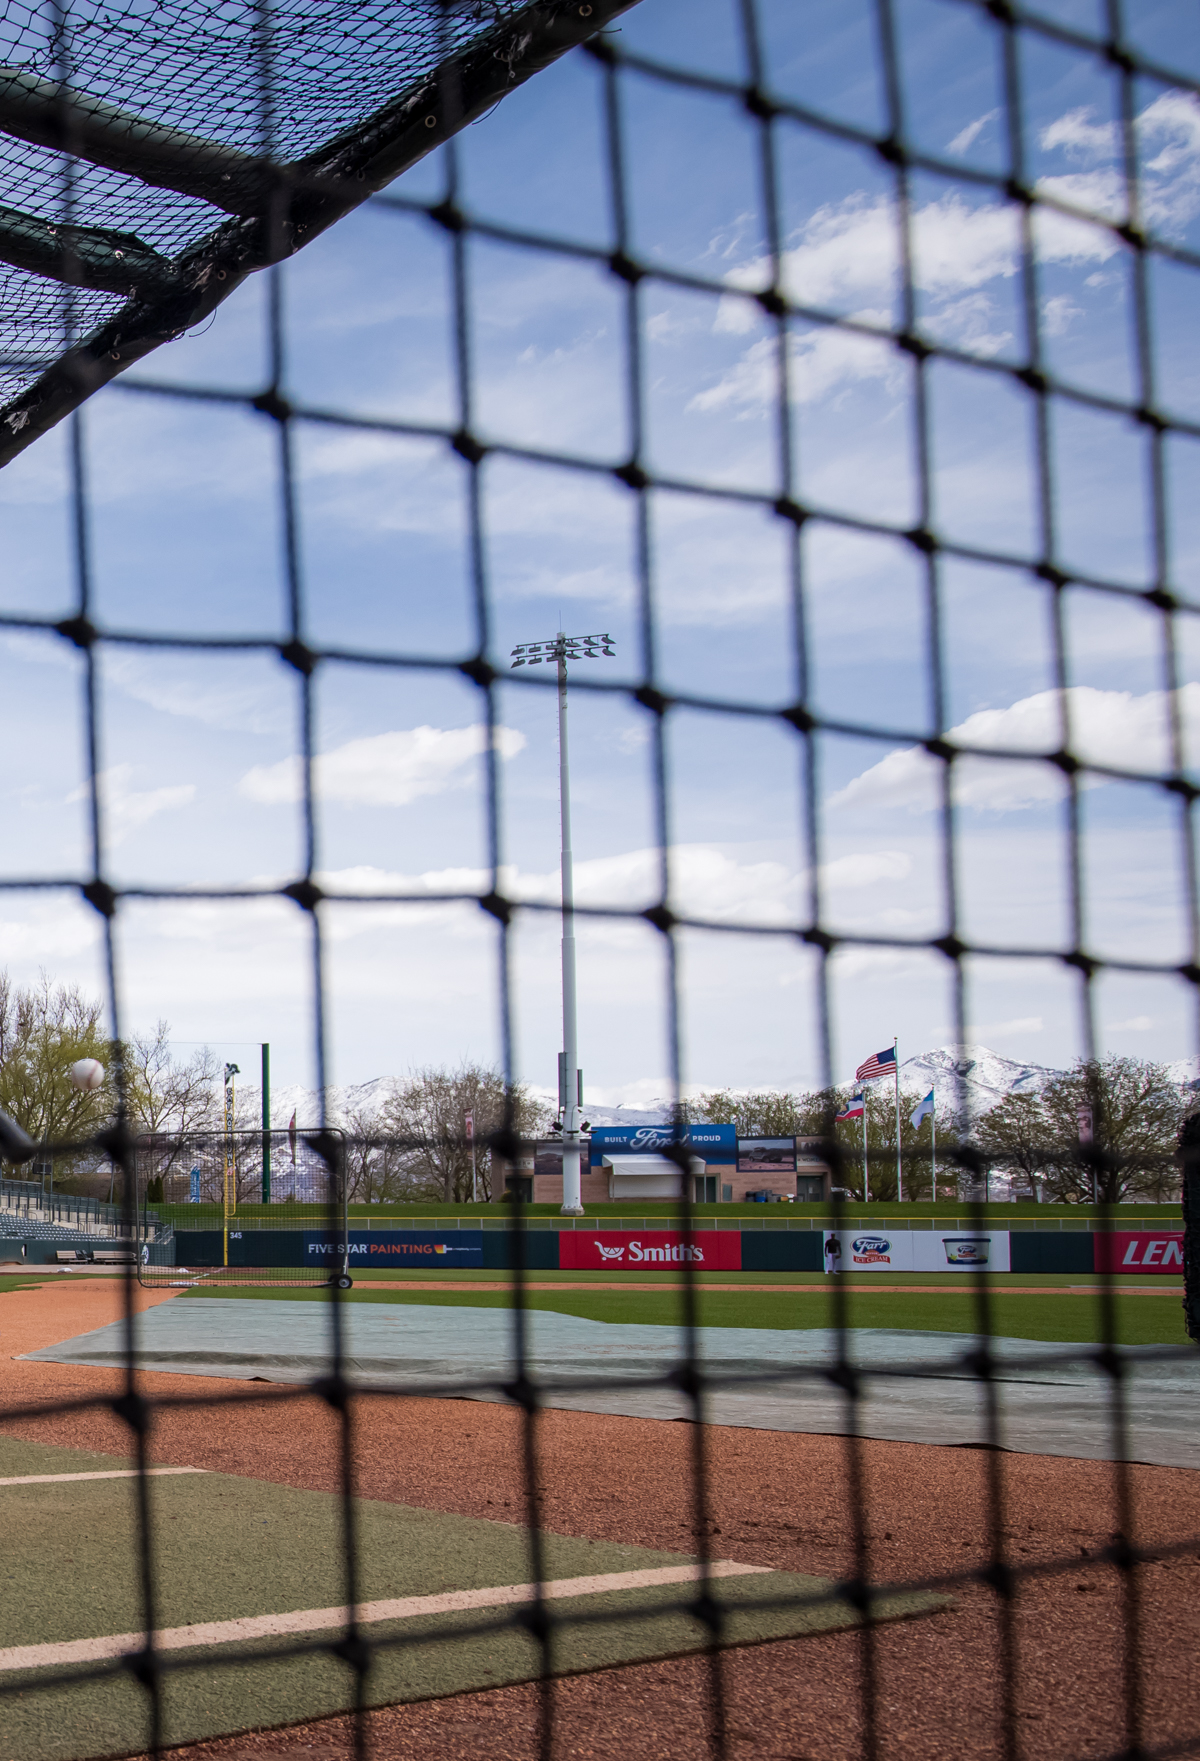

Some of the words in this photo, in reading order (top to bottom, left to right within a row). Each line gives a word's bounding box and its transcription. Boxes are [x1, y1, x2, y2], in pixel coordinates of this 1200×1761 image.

[630, 1128, 689, 1150] Ford
[229, 1232, 243, 1240] 345
[308, 1244, 335, 1254] FIVE
[337, 1244, 368, 1254] STAR
[370, 1244, 433, 1254] PAINTING
[628, 1241, 704, 1262] Smith's
[856, 1236, 887, 1254] Farr
[866, 1255, 888, 1263] CREAM
